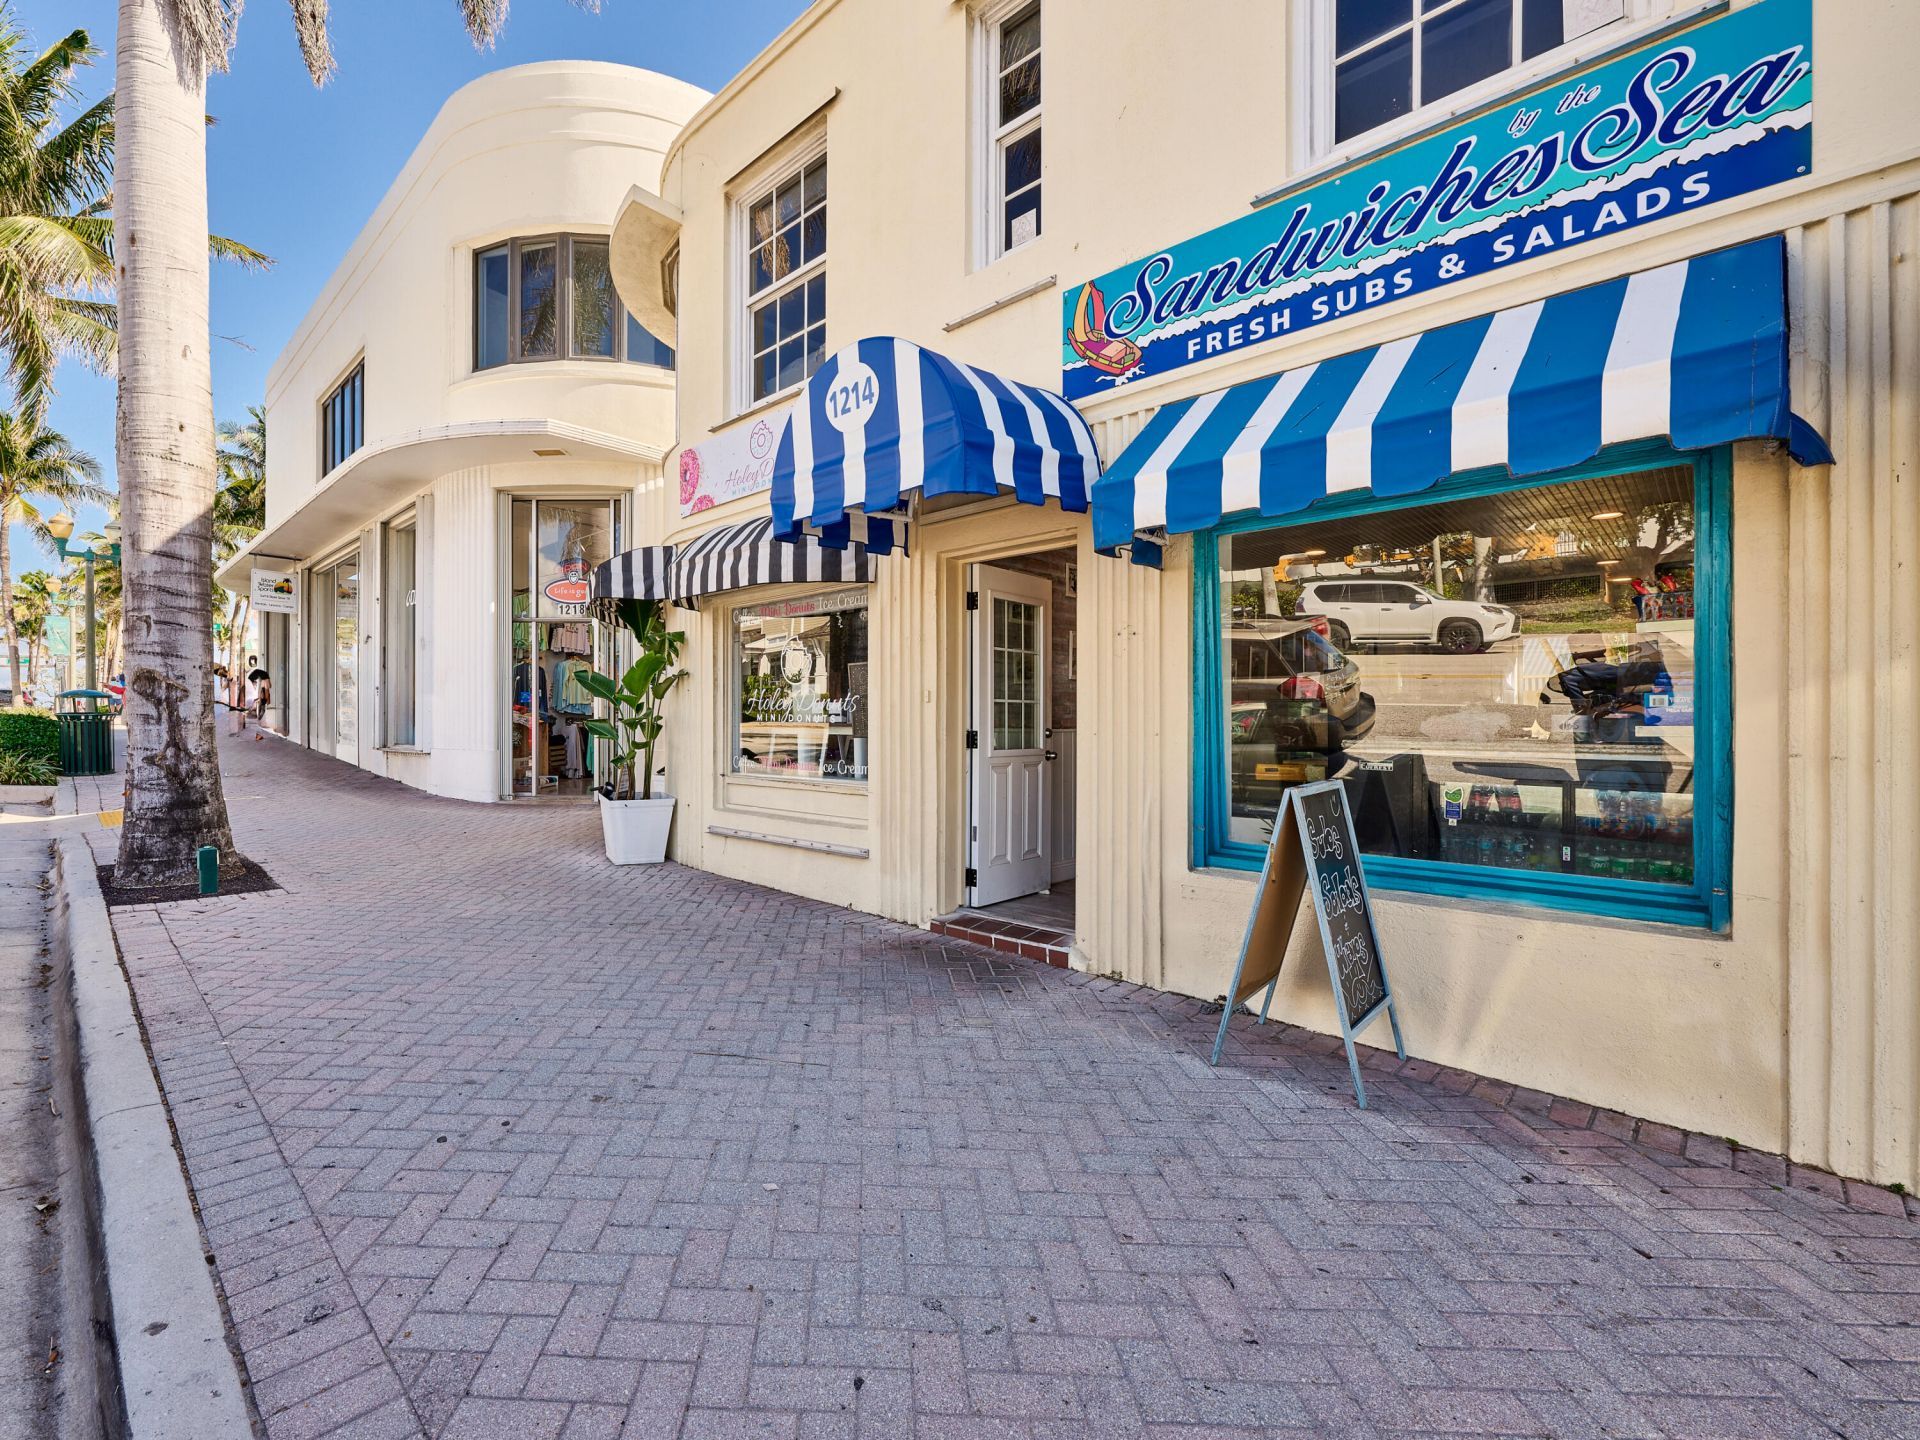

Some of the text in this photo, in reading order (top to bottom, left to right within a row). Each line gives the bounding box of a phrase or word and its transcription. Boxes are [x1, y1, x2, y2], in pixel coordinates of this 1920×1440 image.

[1103, 45, 1810, 341] Sandwiches by the Sea
[1187, 171, 1711, 360] FRESH SUBS & SALADS
[829, 375, 875, 418] 1214
[723, 464, 760, 493] Holey
[559, 605, 586, 615] 1218
[783, 600, 816, 616] Donuts
[818, 597, 834, 610] Ice
[745, 688, 860, 722] Holey Donuts
[756, 713, 836, 723] MINI DONUTS
[819, 758, 835, 773] ce
[1306, 815, 1344, 860] Subs
[1319, 865, 1364, 920] Salads
